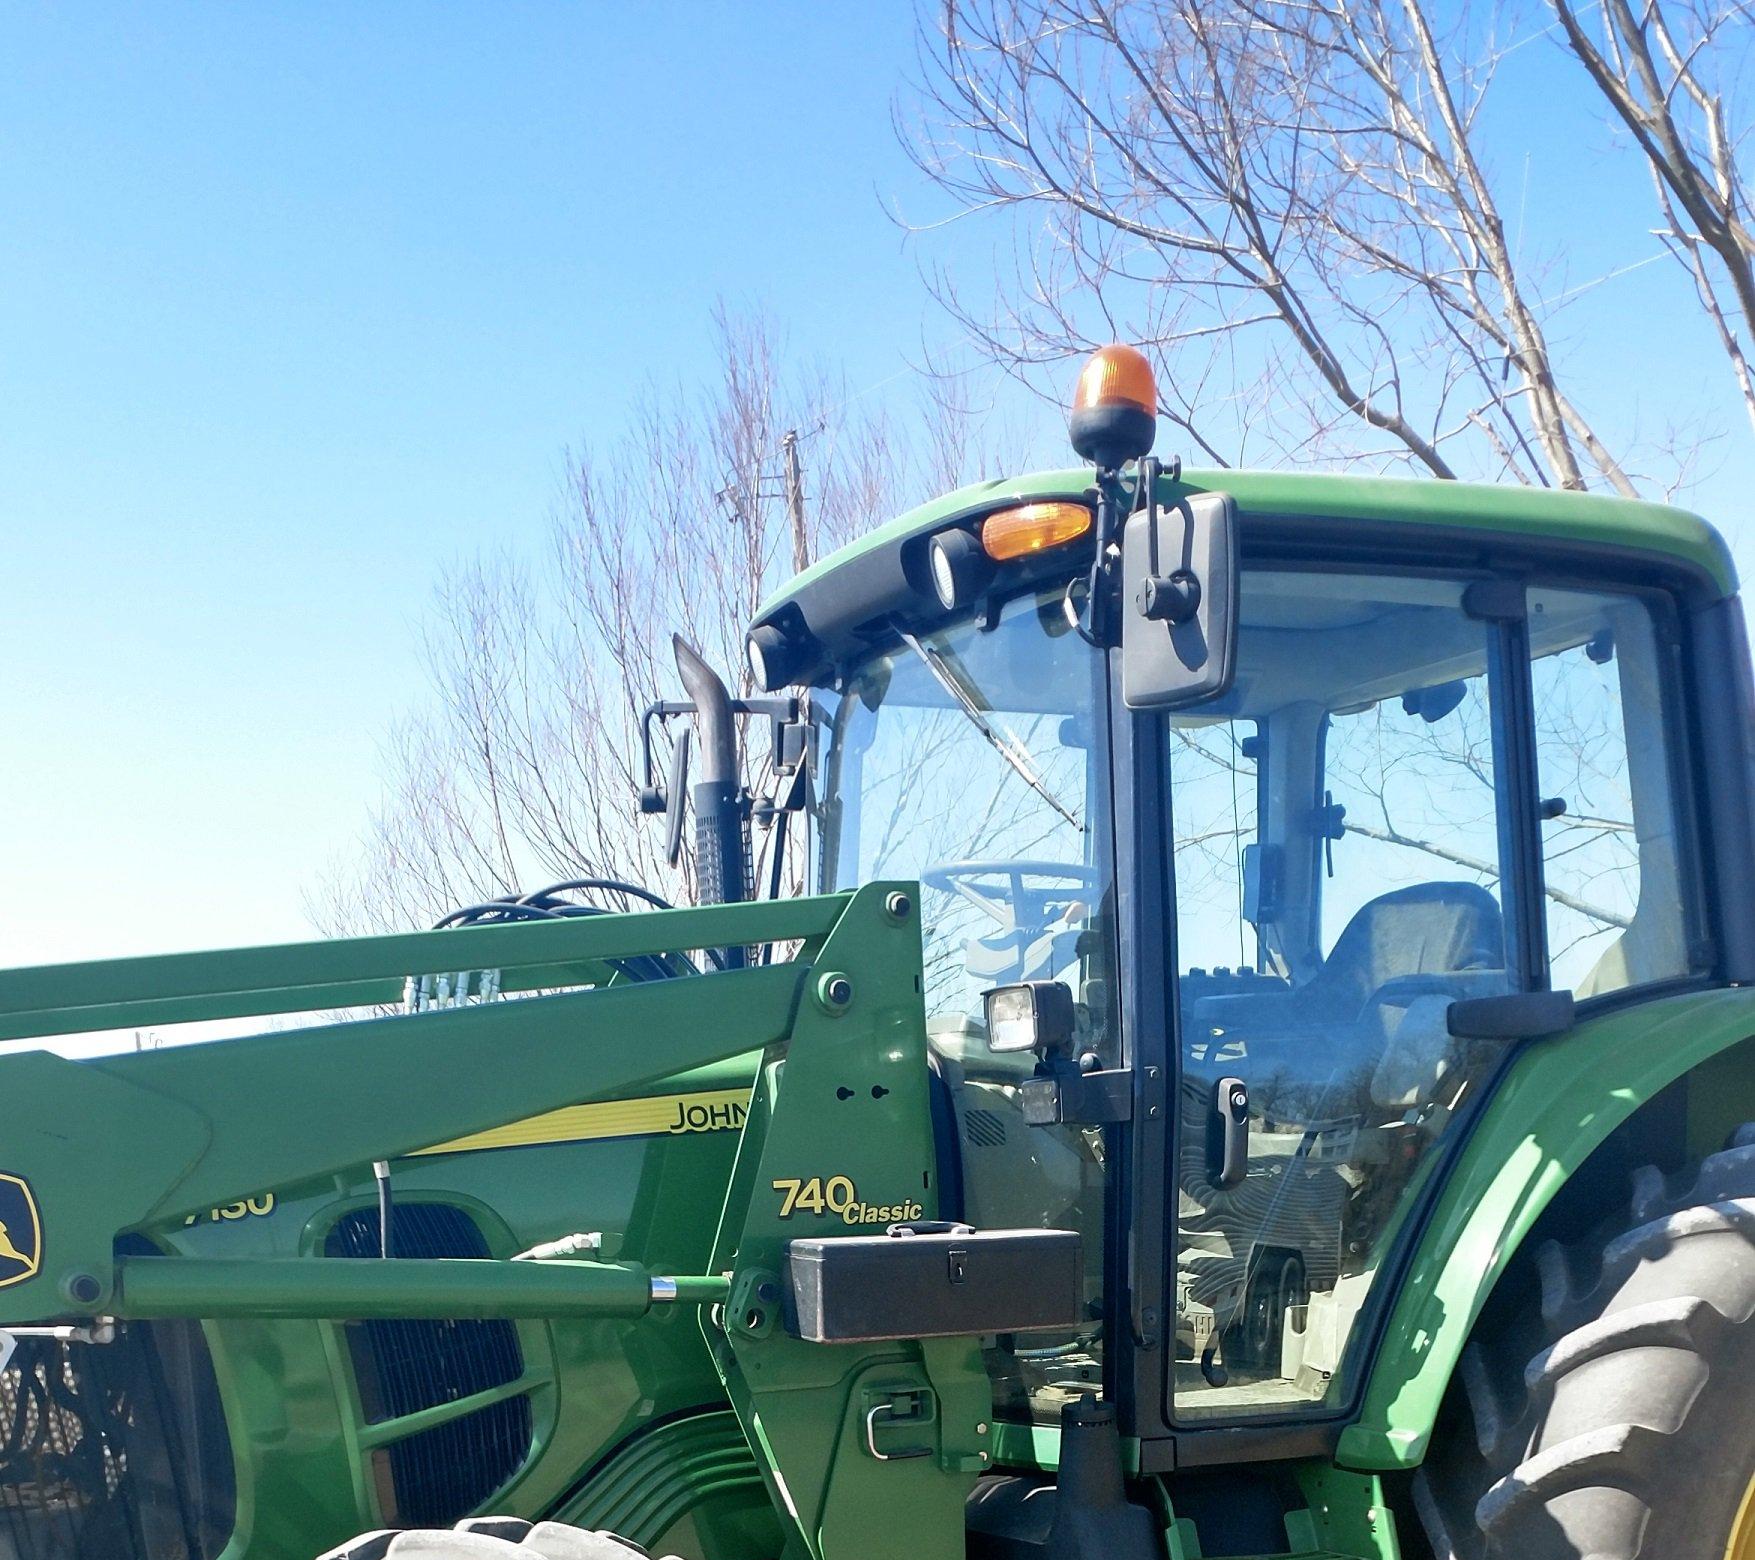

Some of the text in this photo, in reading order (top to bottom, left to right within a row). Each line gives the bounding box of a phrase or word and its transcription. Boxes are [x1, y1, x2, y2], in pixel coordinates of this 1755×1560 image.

[669, 1101, 750, 1131] JOHN
[772, 1175, 923, 1225] 740 Classic
